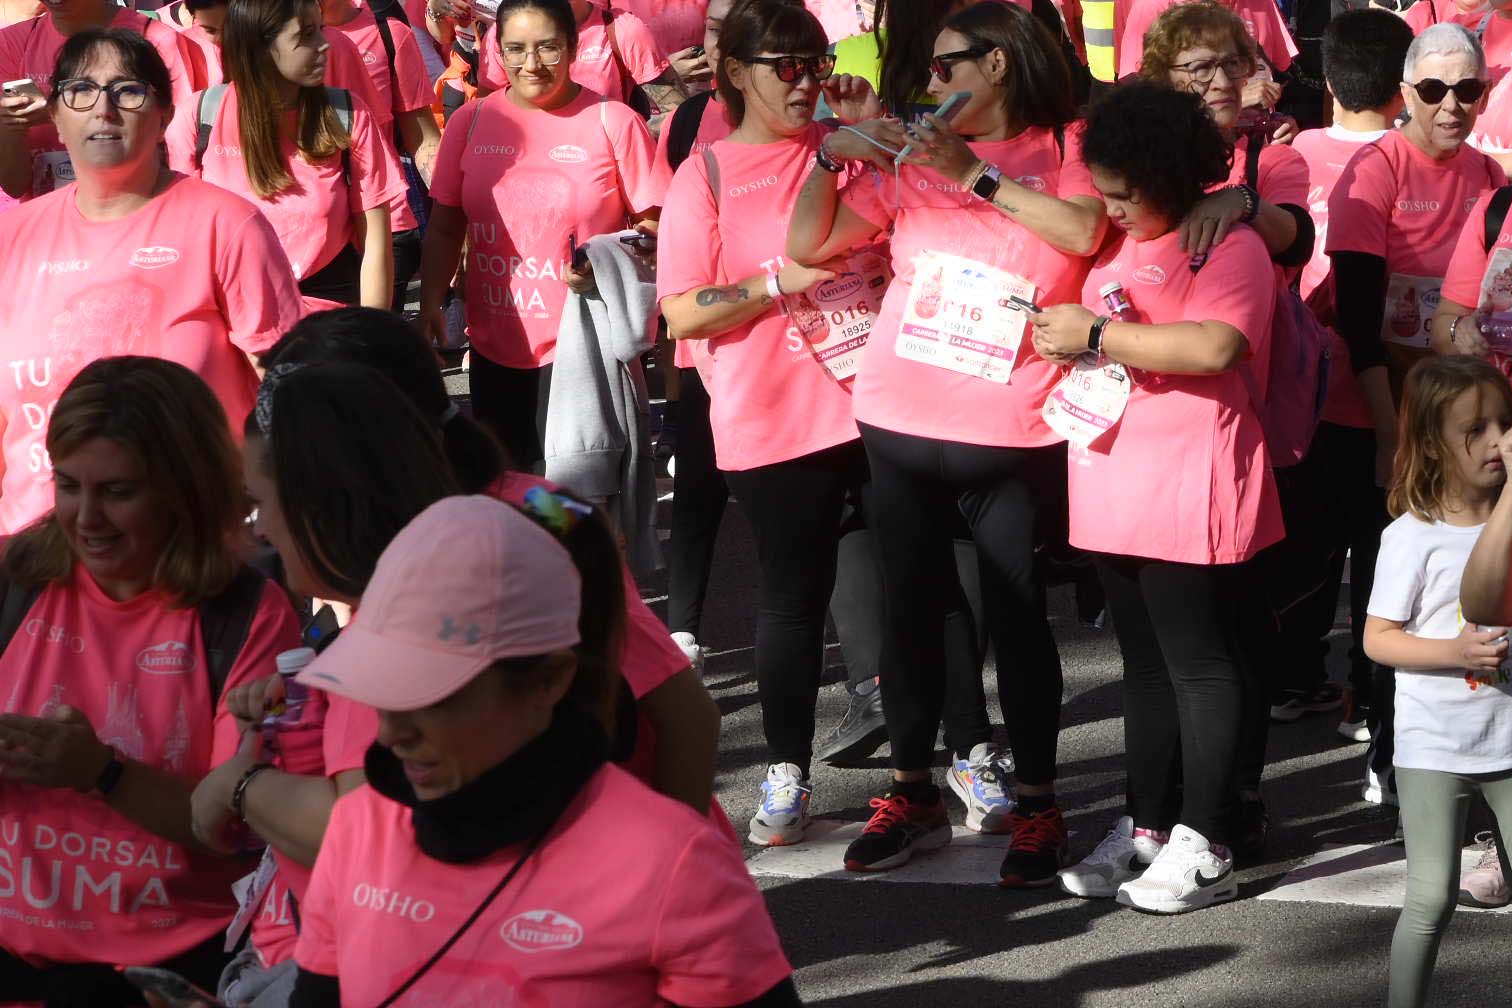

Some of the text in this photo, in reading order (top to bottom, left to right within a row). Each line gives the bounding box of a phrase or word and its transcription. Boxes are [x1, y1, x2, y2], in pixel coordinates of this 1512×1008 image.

[474, 145, 515, 156] OYSHO
[729, 175, 777, 198] OYSHO
[1398, 199, 1440, 211] OYSHO
[471, 223, 496, 243] TU
[831, 301, 870, 326] 016
[841, 320, 871, 338] 18925
[9, 358, 52, 390] TU
[34, 824, 181, 870] DORSAL
